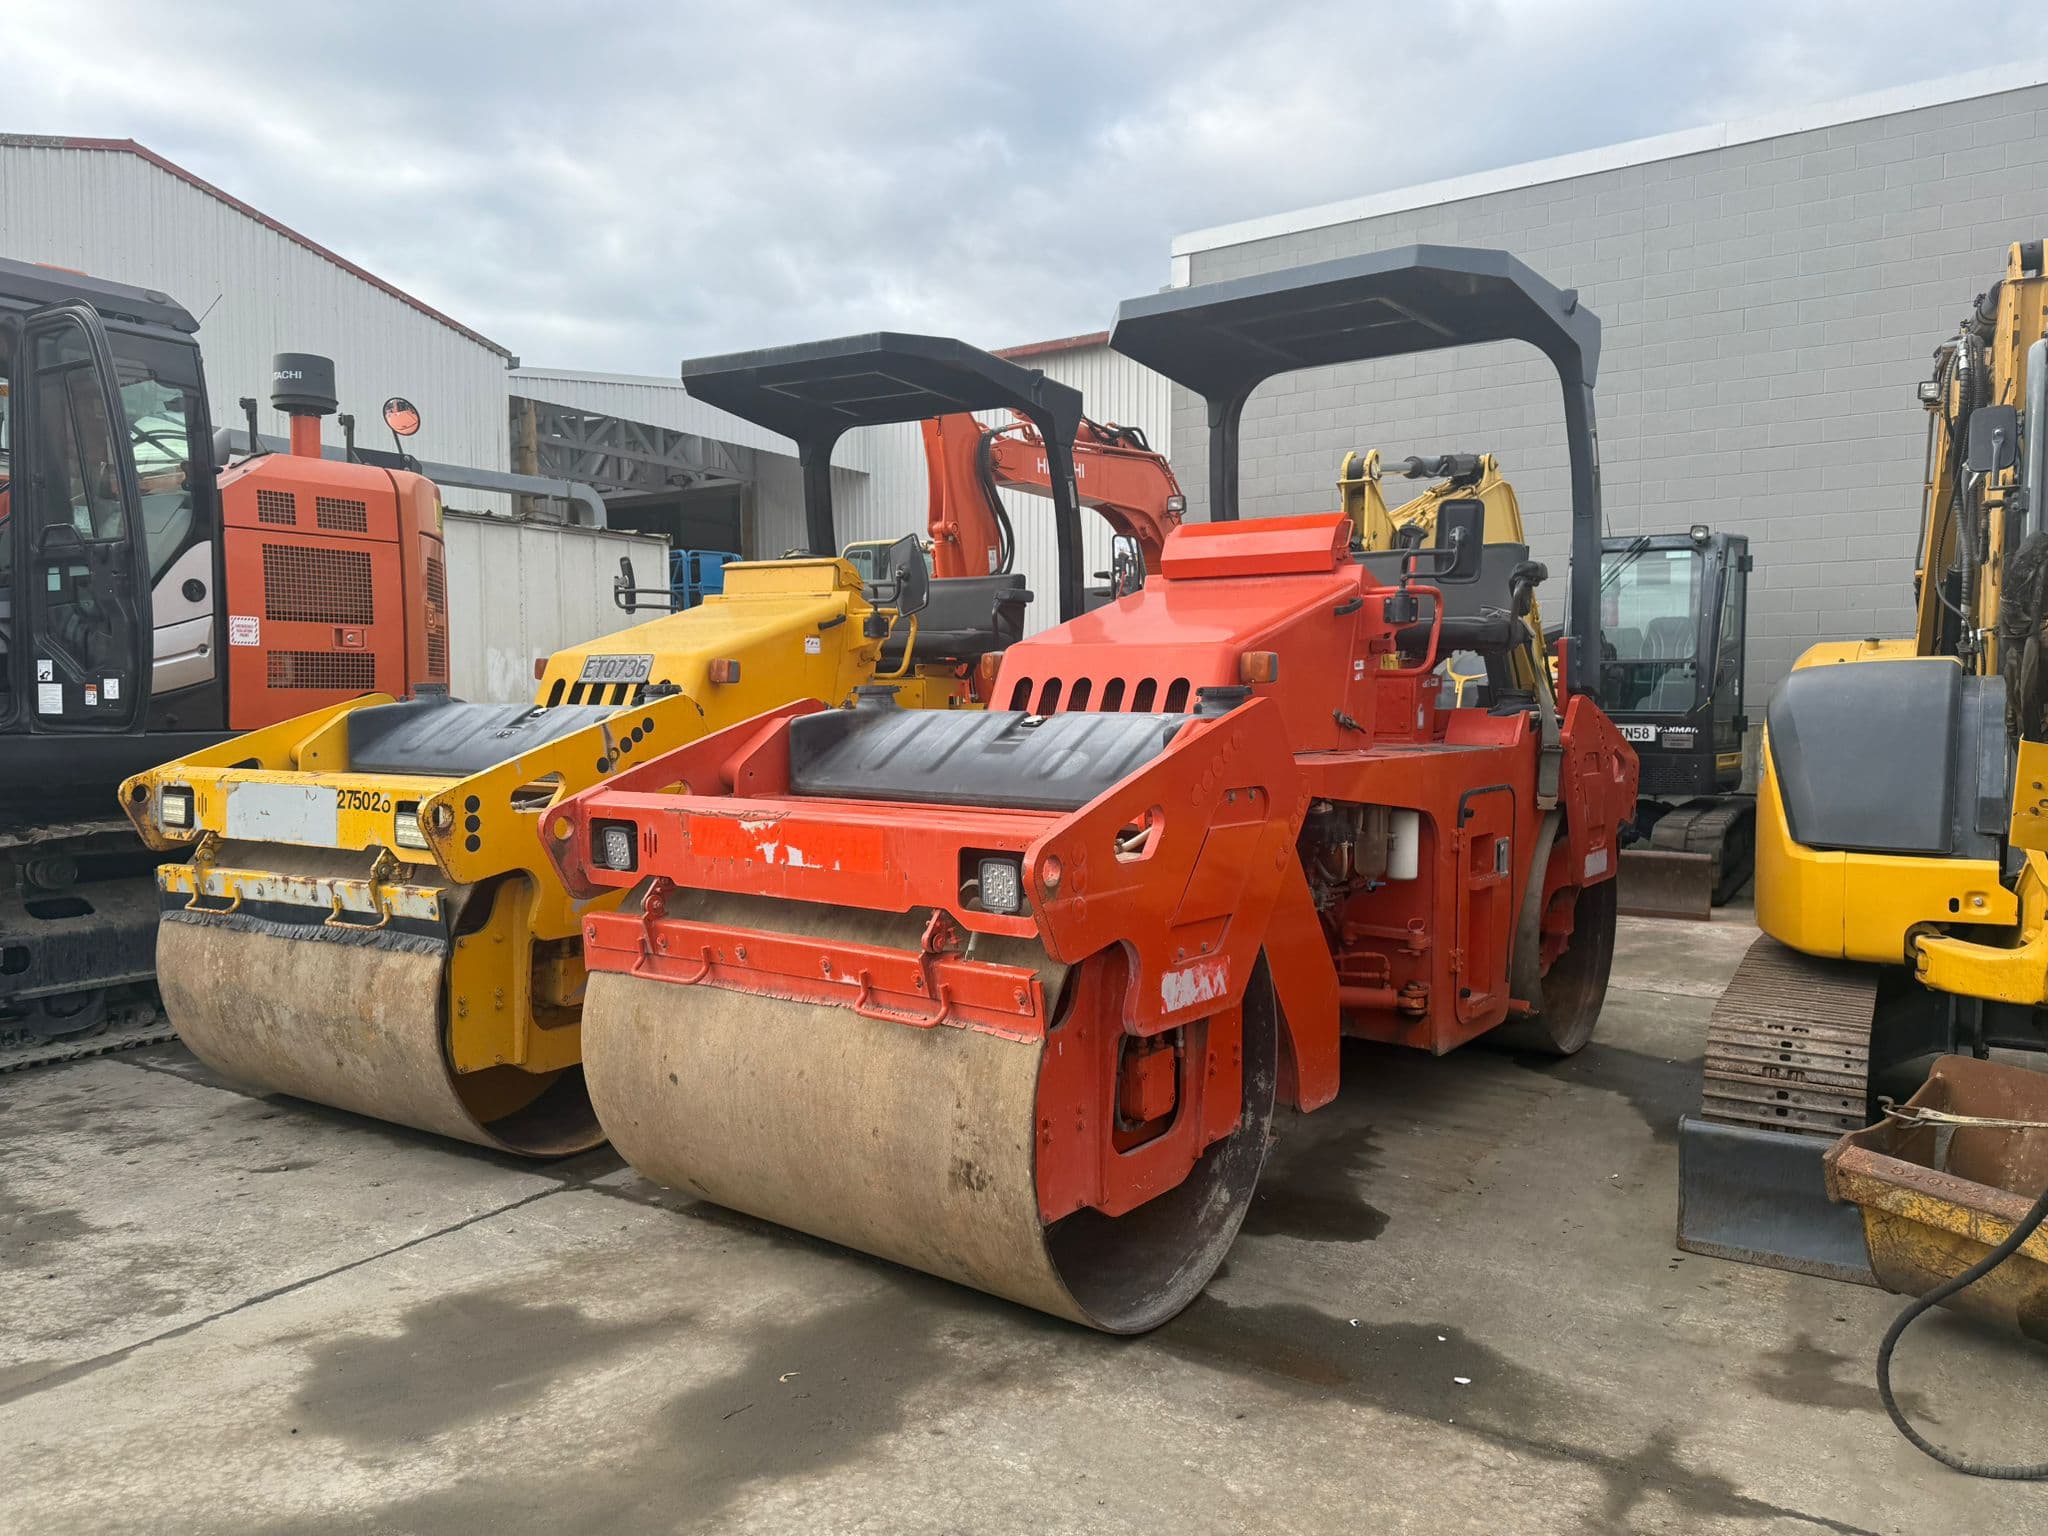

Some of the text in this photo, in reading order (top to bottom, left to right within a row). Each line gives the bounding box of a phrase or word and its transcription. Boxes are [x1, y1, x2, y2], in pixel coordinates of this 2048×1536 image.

[1037, 457, 1085, 479] HIHI
[582, 659, 648, 678] ETQ736
[1617, 727, 1650, 740] TN58
